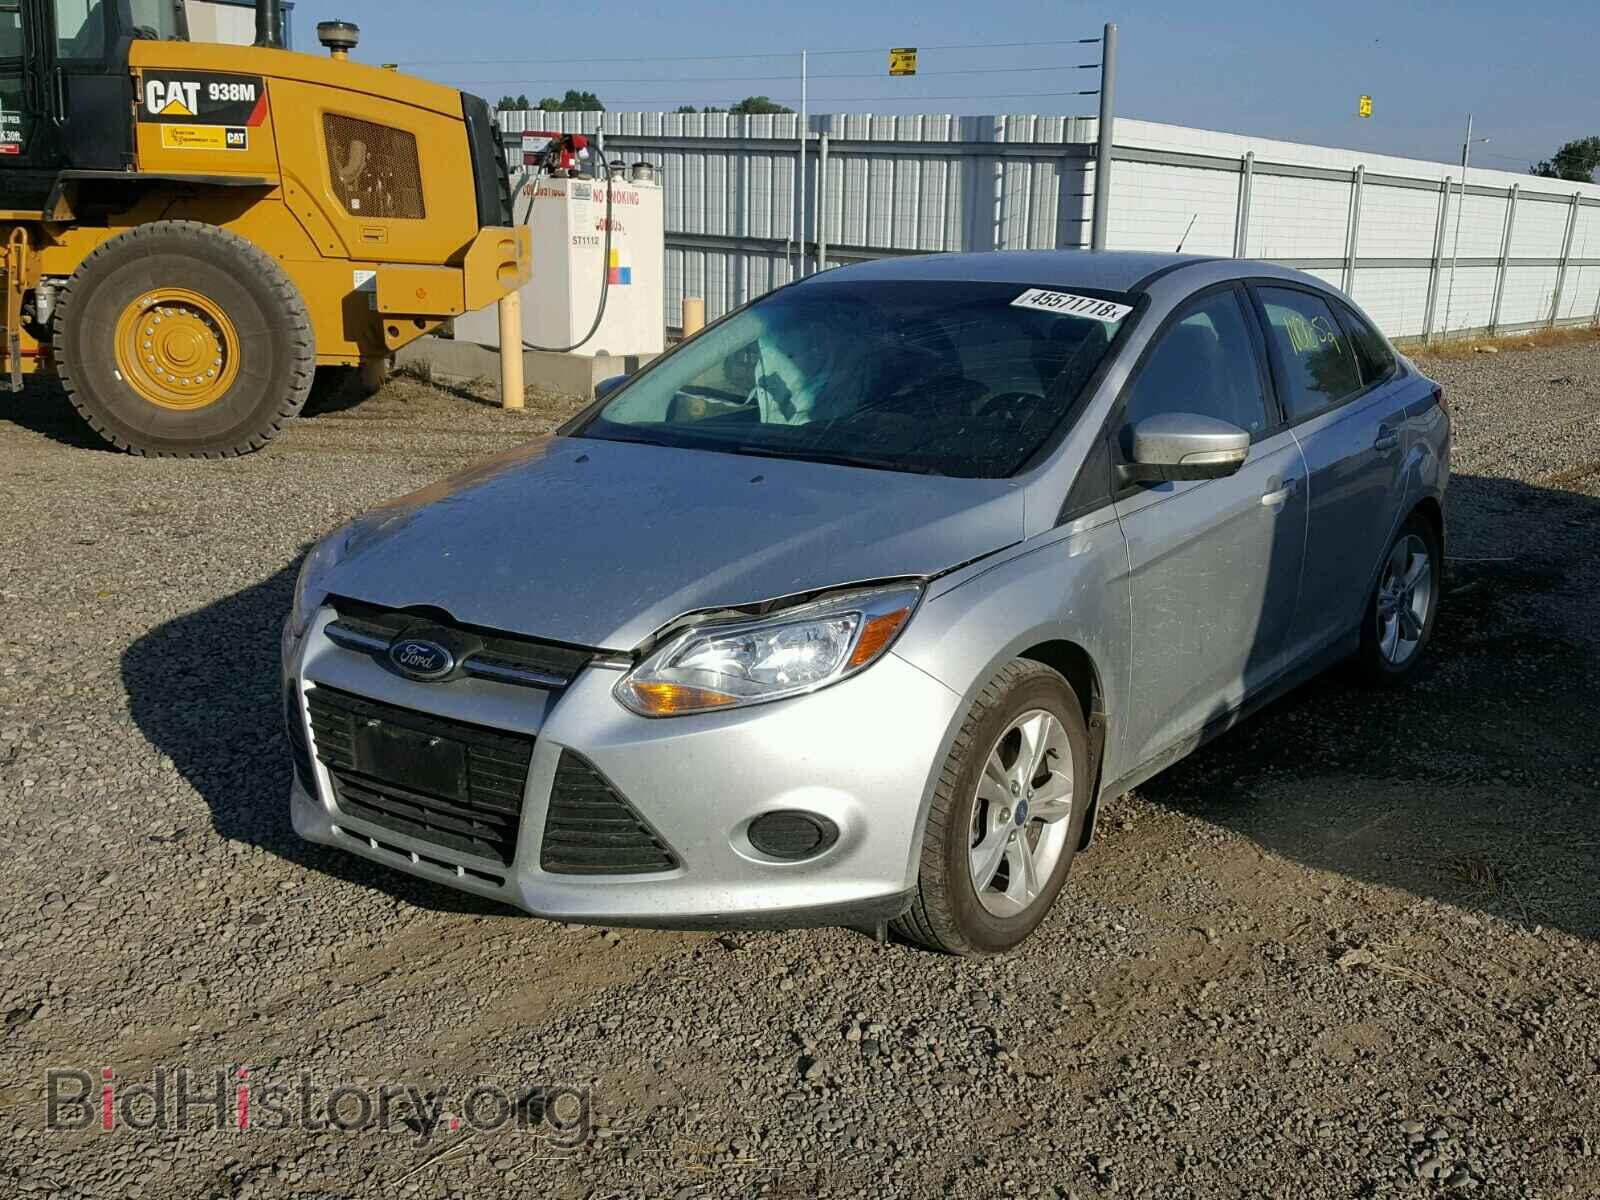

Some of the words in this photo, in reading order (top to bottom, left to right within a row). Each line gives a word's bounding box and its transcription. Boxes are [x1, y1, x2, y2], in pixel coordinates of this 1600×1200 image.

[146, 80, 200, 115] CAT
[208, 83, 255, 101] 938M
[227, 132, 245, 144] CAT
[593, 189, 604, 202] NO
[606, 190, 640, 205] MOKING
[572, 236, 600, 245] ST1112
[400, 644, 434, 669] Ford
